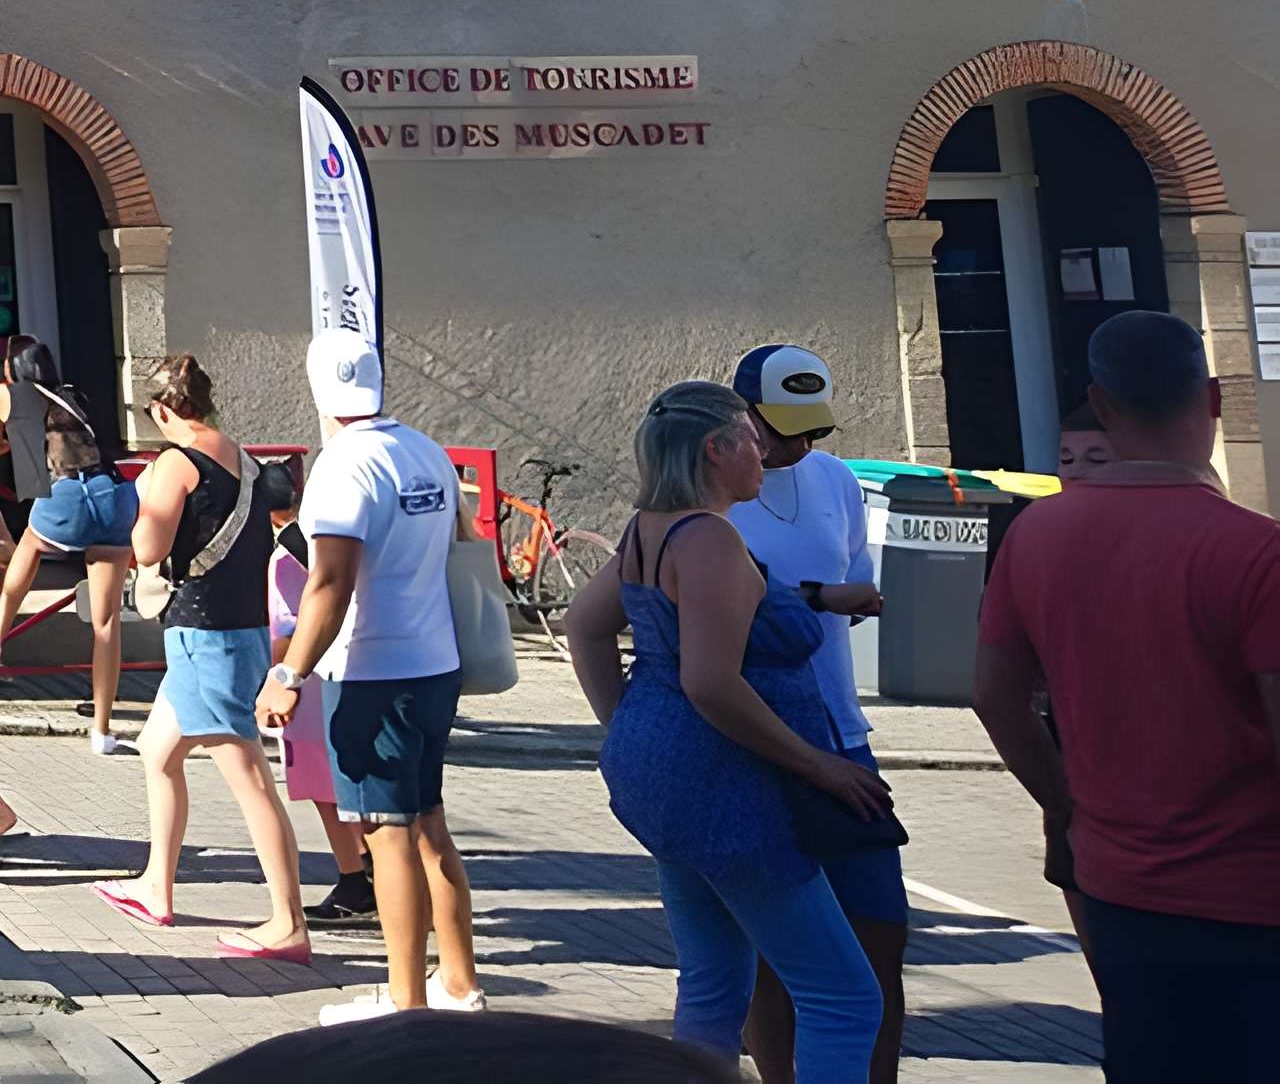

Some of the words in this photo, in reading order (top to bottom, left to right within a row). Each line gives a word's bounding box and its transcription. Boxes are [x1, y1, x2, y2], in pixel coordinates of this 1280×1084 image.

[341, 68, 460, 93] OFFICE
[470, 68, 510, 92] DE
[523, 66, 694, 91] TOURISME
[357, 124, 420, 148] AVE
[436, 124, 500, 148] DES
[514, 122, 712, 149] MUSCADET
